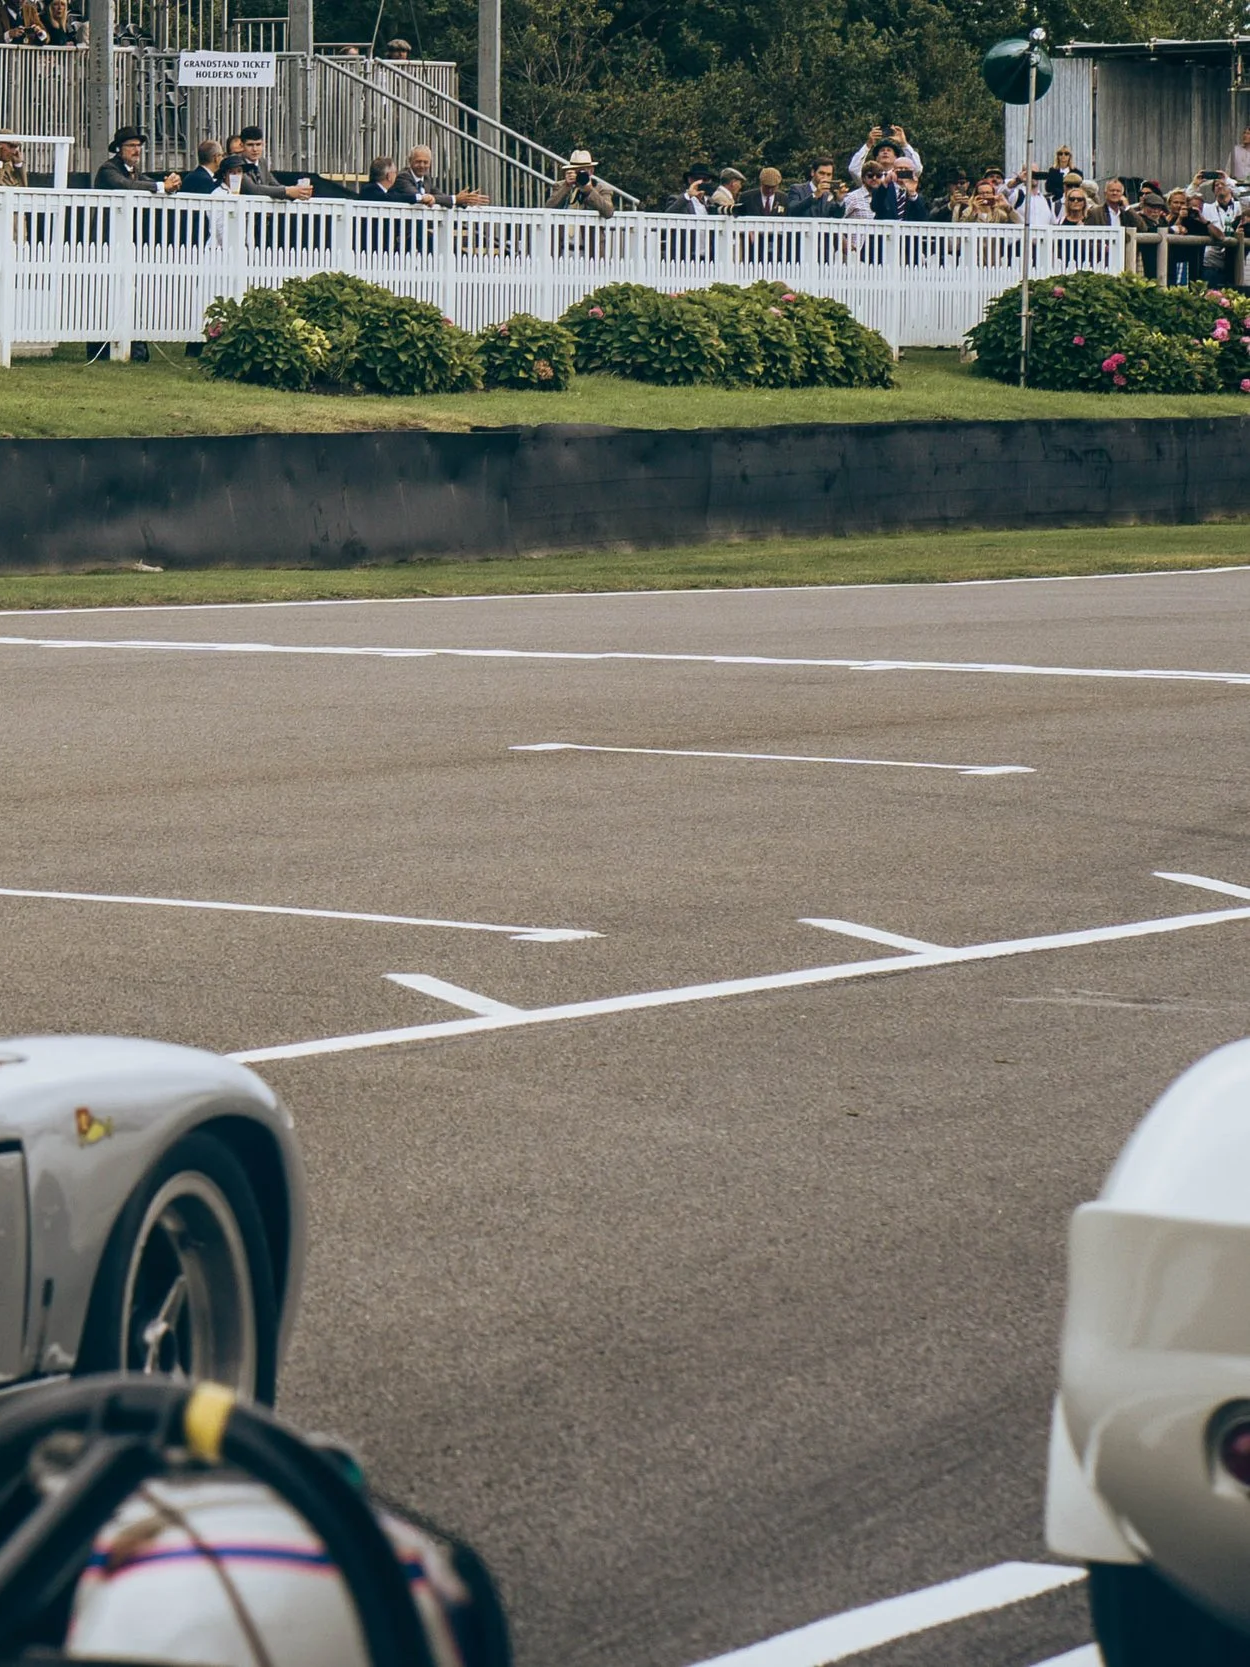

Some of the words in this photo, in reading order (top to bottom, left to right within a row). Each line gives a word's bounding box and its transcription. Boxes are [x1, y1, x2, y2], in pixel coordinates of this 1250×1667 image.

[183, 60, 240, 68] GRANDSTAND
[242, 61, 271, 69] TICKET
[195, 71, 234, 79] HOLDERS
